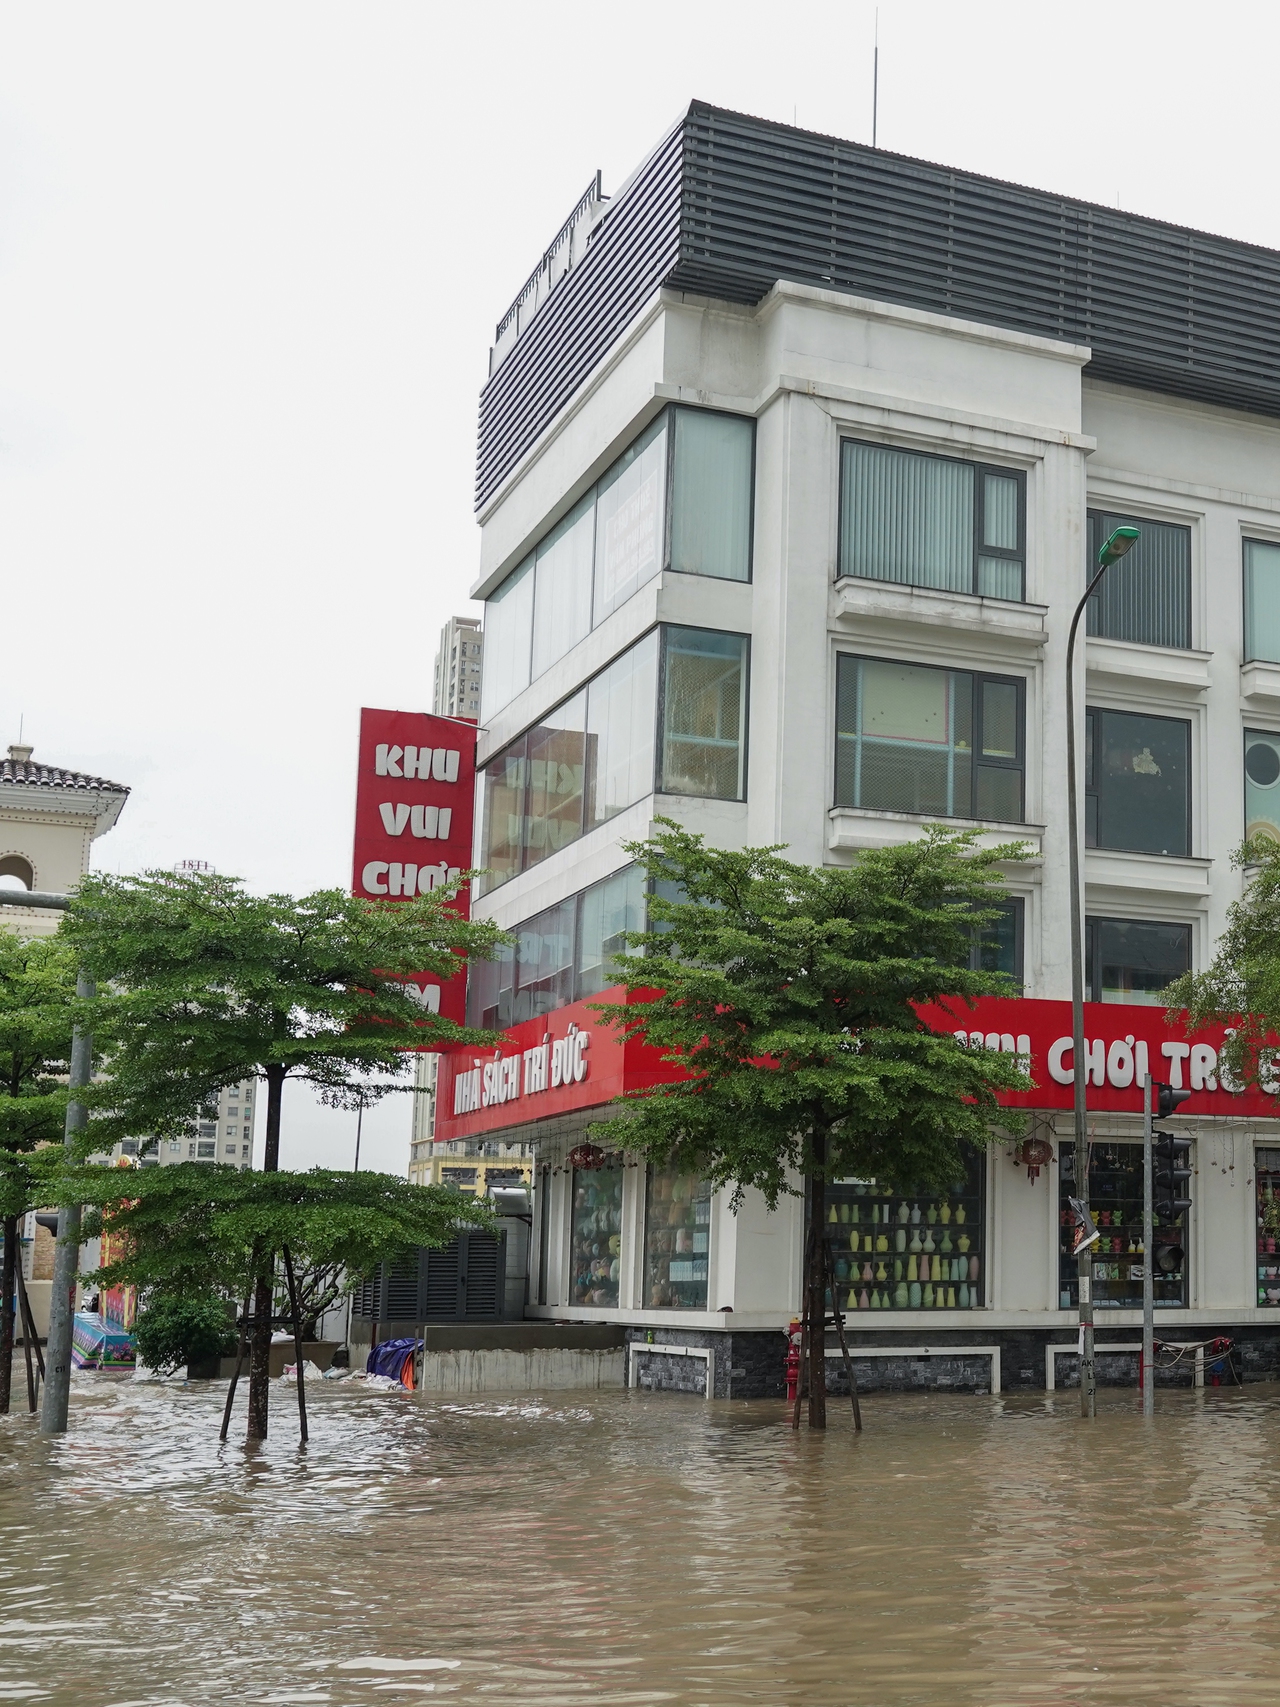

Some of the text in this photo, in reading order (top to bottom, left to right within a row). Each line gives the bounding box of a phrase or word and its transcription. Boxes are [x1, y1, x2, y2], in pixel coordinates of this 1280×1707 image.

[375, 743, 460, 783] KHU
[378, 802, 452, 840] VUI
[362, 861, 460, 900] CHƠI
[454, 1022, 590, 1115] NHÀ SÁCH TRÍ ĐỨC
[1047, 1034, 1149, 1088] CHƠI
